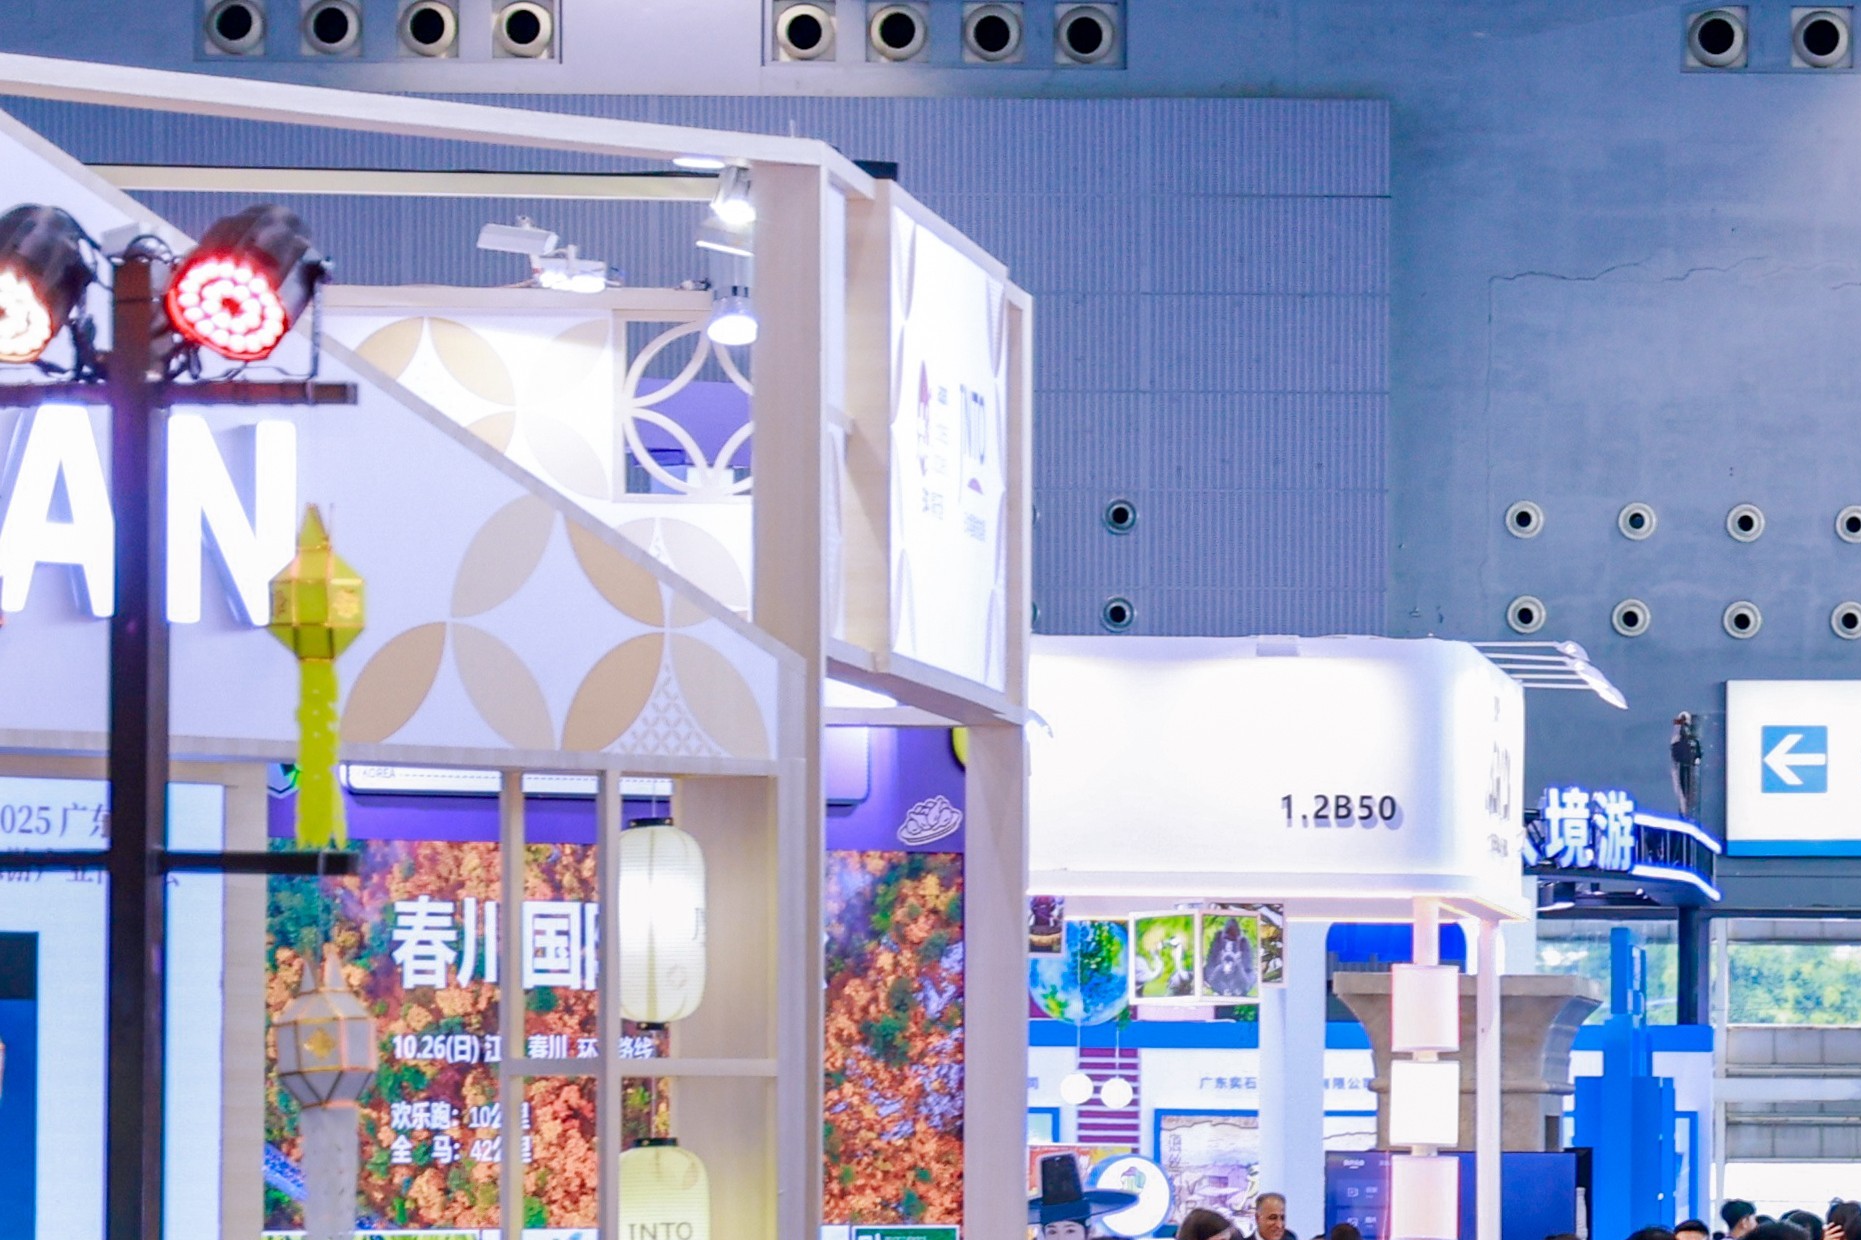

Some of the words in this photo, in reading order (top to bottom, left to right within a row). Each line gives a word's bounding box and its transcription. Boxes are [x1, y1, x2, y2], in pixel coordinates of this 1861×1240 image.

[1281, 793, 1397, 821] 1.2B50
[1522, 786, 1634, 871] 境游
[391, 895, 599, 990] 春川国
